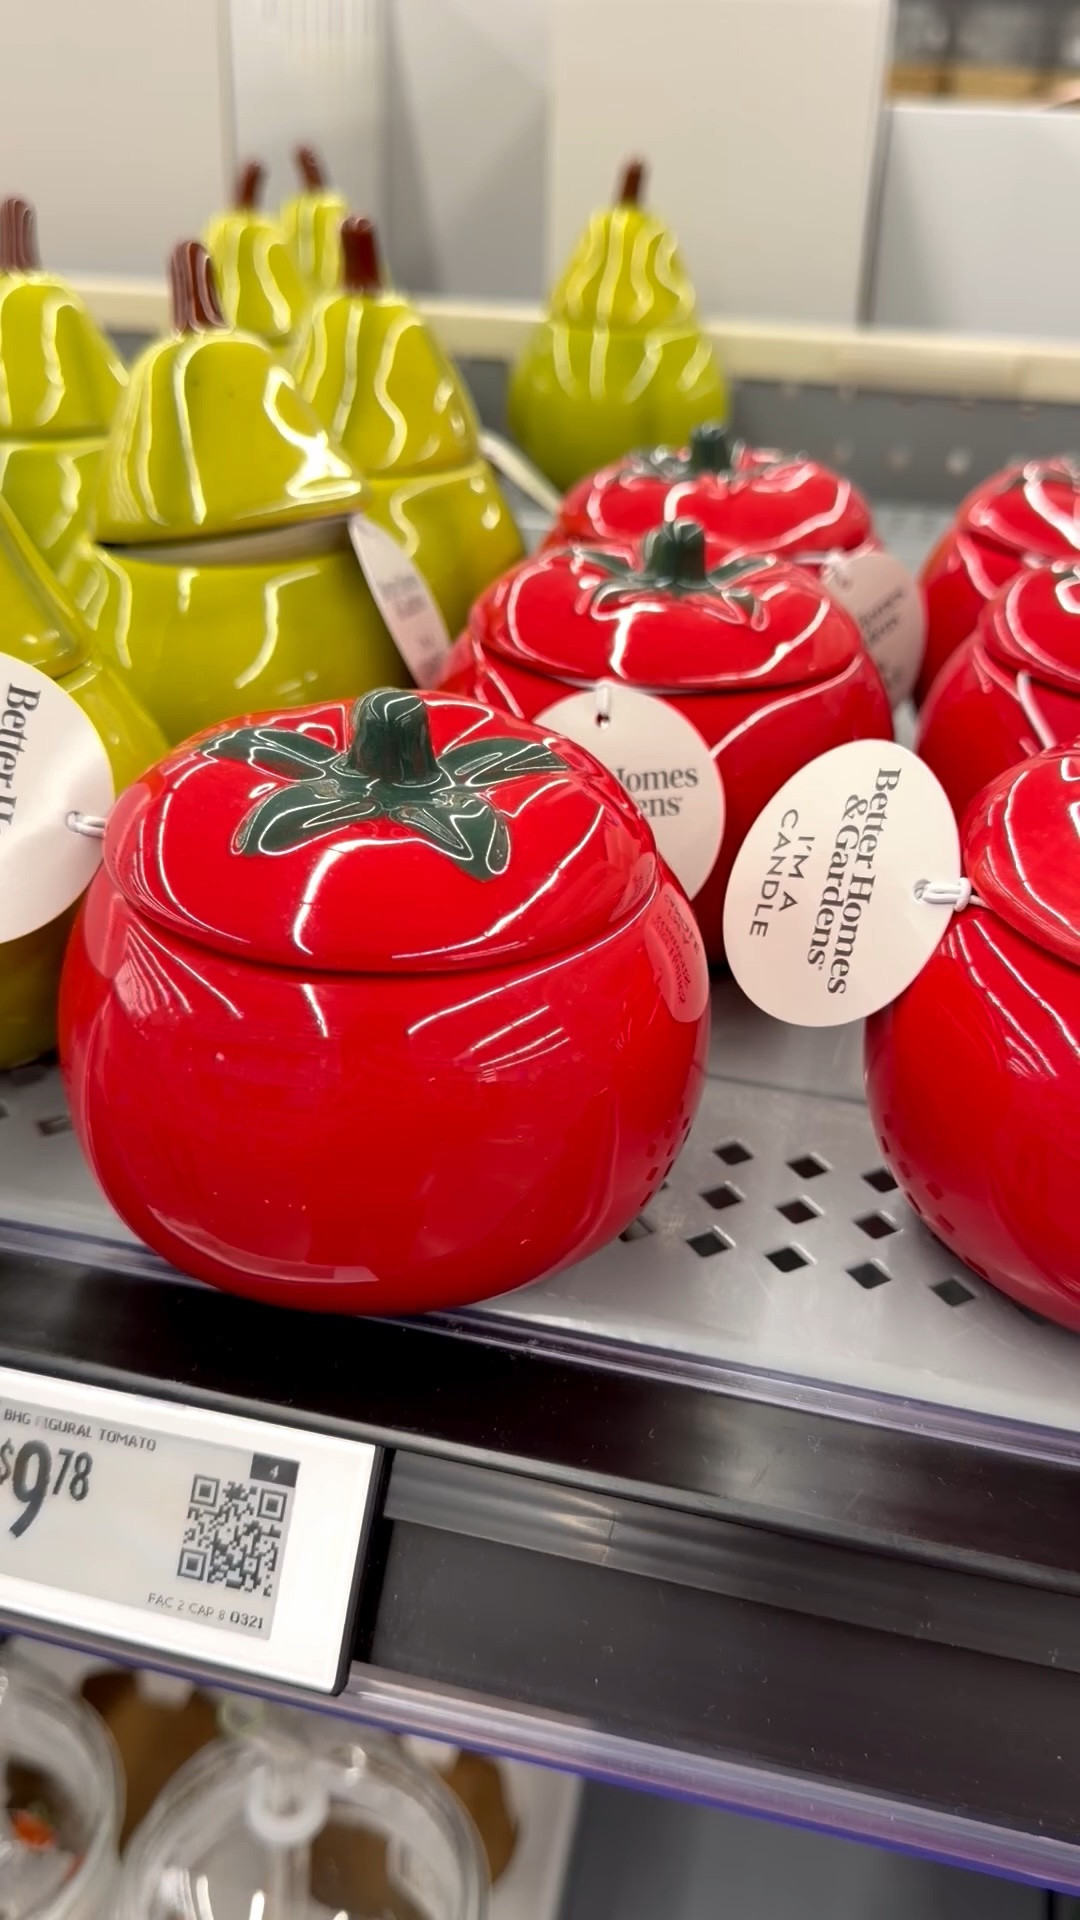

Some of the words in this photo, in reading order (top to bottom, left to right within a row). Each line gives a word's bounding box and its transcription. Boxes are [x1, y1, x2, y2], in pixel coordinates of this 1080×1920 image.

[841, 794, 868, 821] &
[855, 768, 902, 869] Better
[749, 809, 799, 938] CANDLE
[788, 836, 815, 879] I'M
[778, 891, 798, 912] A
[807, 824, 860, 968] Gardens
[827, 875, 876, 995] Homes
[4, 1408, 31, 1425] BHG
[100, 1428, 156, 1451] TOMATO
[270, 1465, 279, 1479] 4
[147, 1592, 174, 1609] FAC
[177, 1600, 185, 1611] 2
[188, 1602, 214, 1617] CAP
[230, 1611, 264, 1629] 0321
